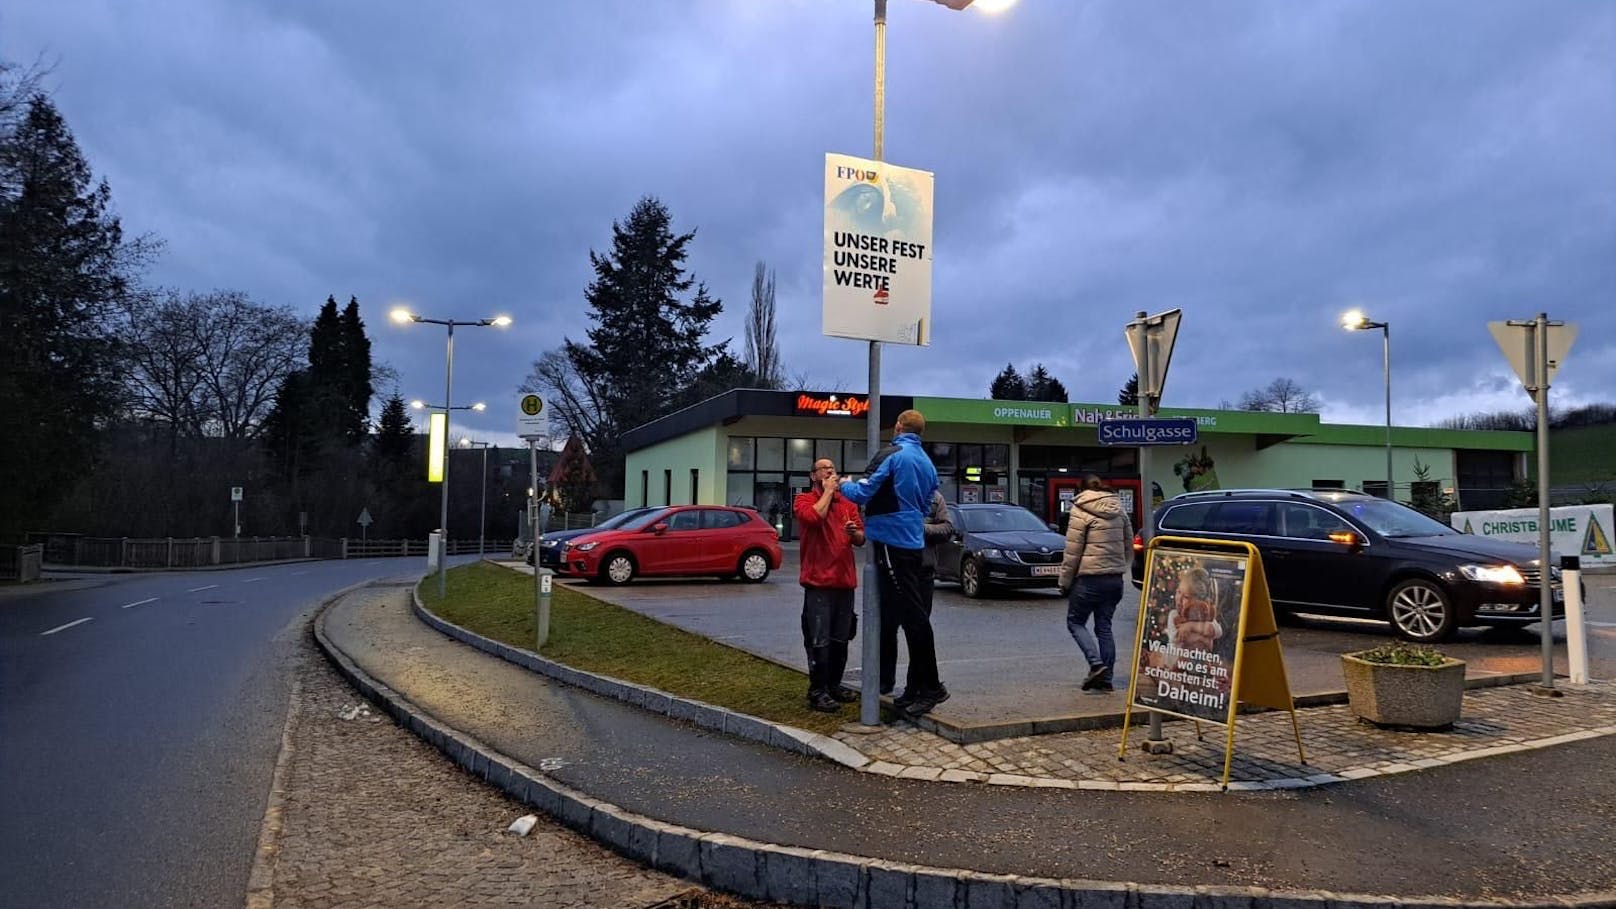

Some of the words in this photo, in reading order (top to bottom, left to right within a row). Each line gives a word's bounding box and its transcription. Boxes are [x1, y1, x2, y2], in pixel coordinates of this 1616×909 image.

[834, 231, 888, 254] UNSER
[892, 241, 925, 259] FEST
[834, 250, 897, 274] UNSERE
[834, 269, 890, 291] WERTE
[798, 395, 840, 415] Magic
[841, 397, 870, 416] Styl
[994, 407, 1051, 419] OPPENAUER
[1103, 424, 1191, 441] Schulgasse
[1483, 517, 1577, 535] CHRISTBUME
[1148, 639, 1223, 665] Weihnachten,
[1144, 665, 1200, 686] schönsten
[1202, 675, 1219, 690] ist:
[1177, 659, 1193, 671] wo
[1195, 662, 1207, 674] es
[1210, 664, 1227, 677] am
[1157, 680, 1224, 710] Daheim!
